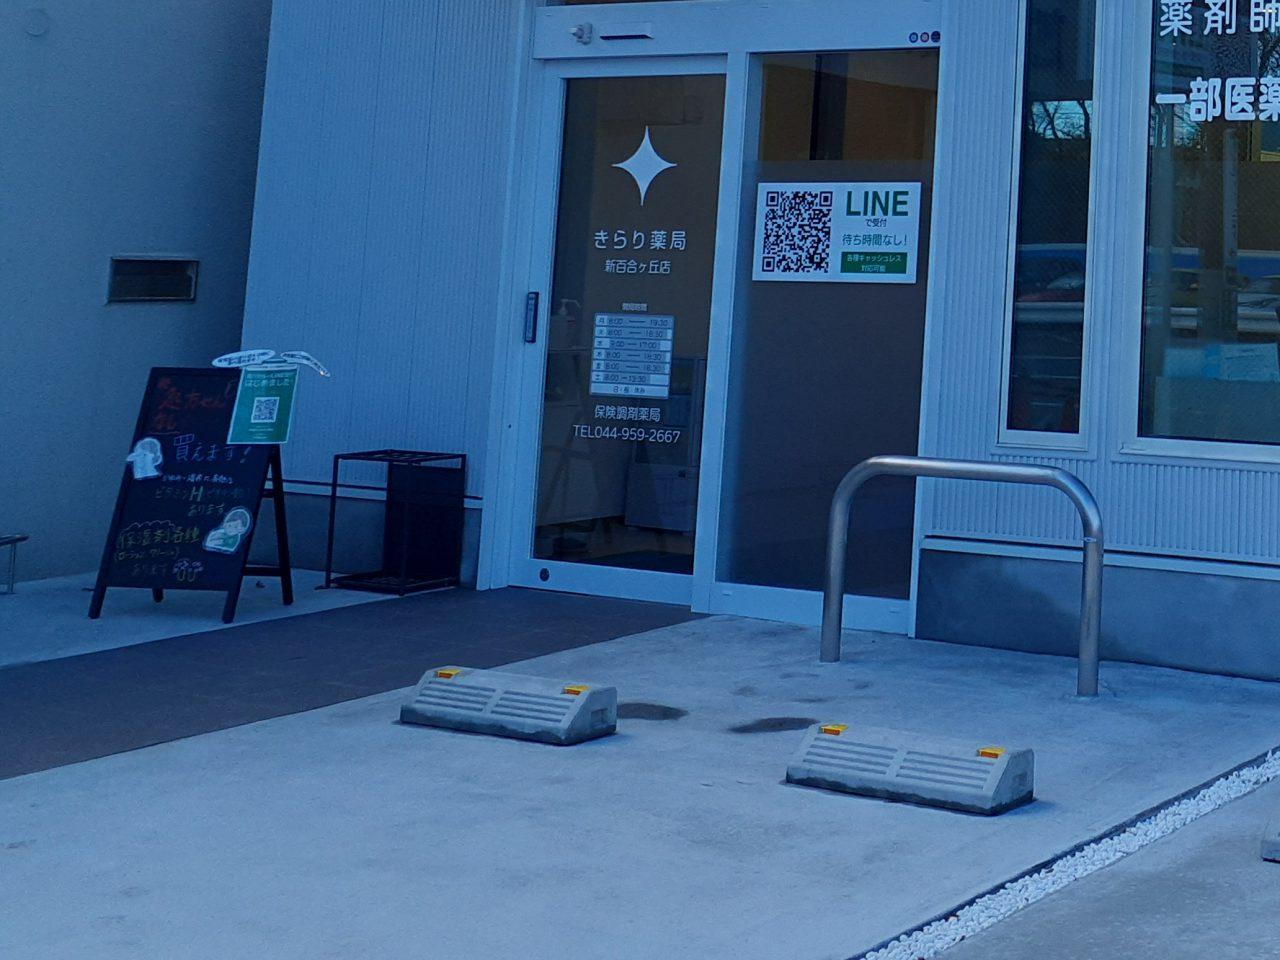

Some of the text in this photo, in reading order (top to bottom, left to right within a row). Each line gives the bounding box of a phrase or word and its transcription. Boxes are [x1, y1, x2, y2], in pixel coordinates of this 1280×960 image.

[846, 190, 909, 216] LINE
[865, 218, 887, 228] で受付
[594, 230, 687, 251] きらり薬局
[604, 259, 671, 274] 新百合ヶ丘店
[594, 404, 661, 422] 保険調剤薬局
[573, 424, 681, 443] TEL044-959-2667
